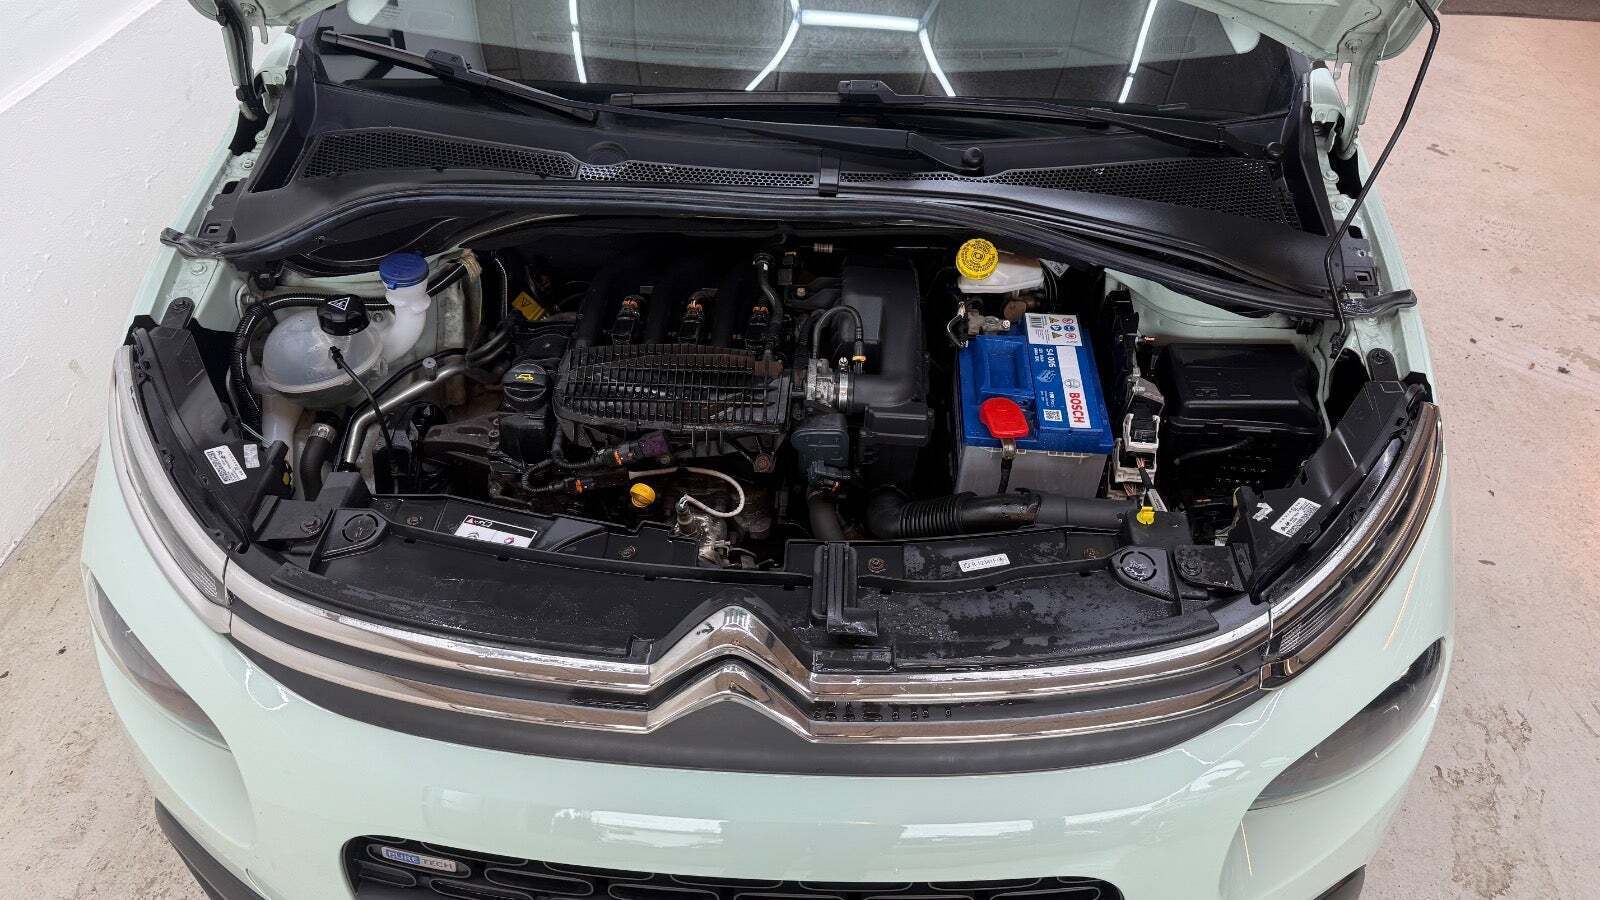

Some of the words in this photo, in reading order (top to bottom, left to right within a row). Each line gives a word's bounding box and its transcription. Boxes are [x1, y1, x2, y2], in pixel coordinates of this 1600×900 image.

[1069, 392, 1085, 424] BOSCH
[387, 851, 418, 863] PURE
[423, 858, 453, 870] TECH
